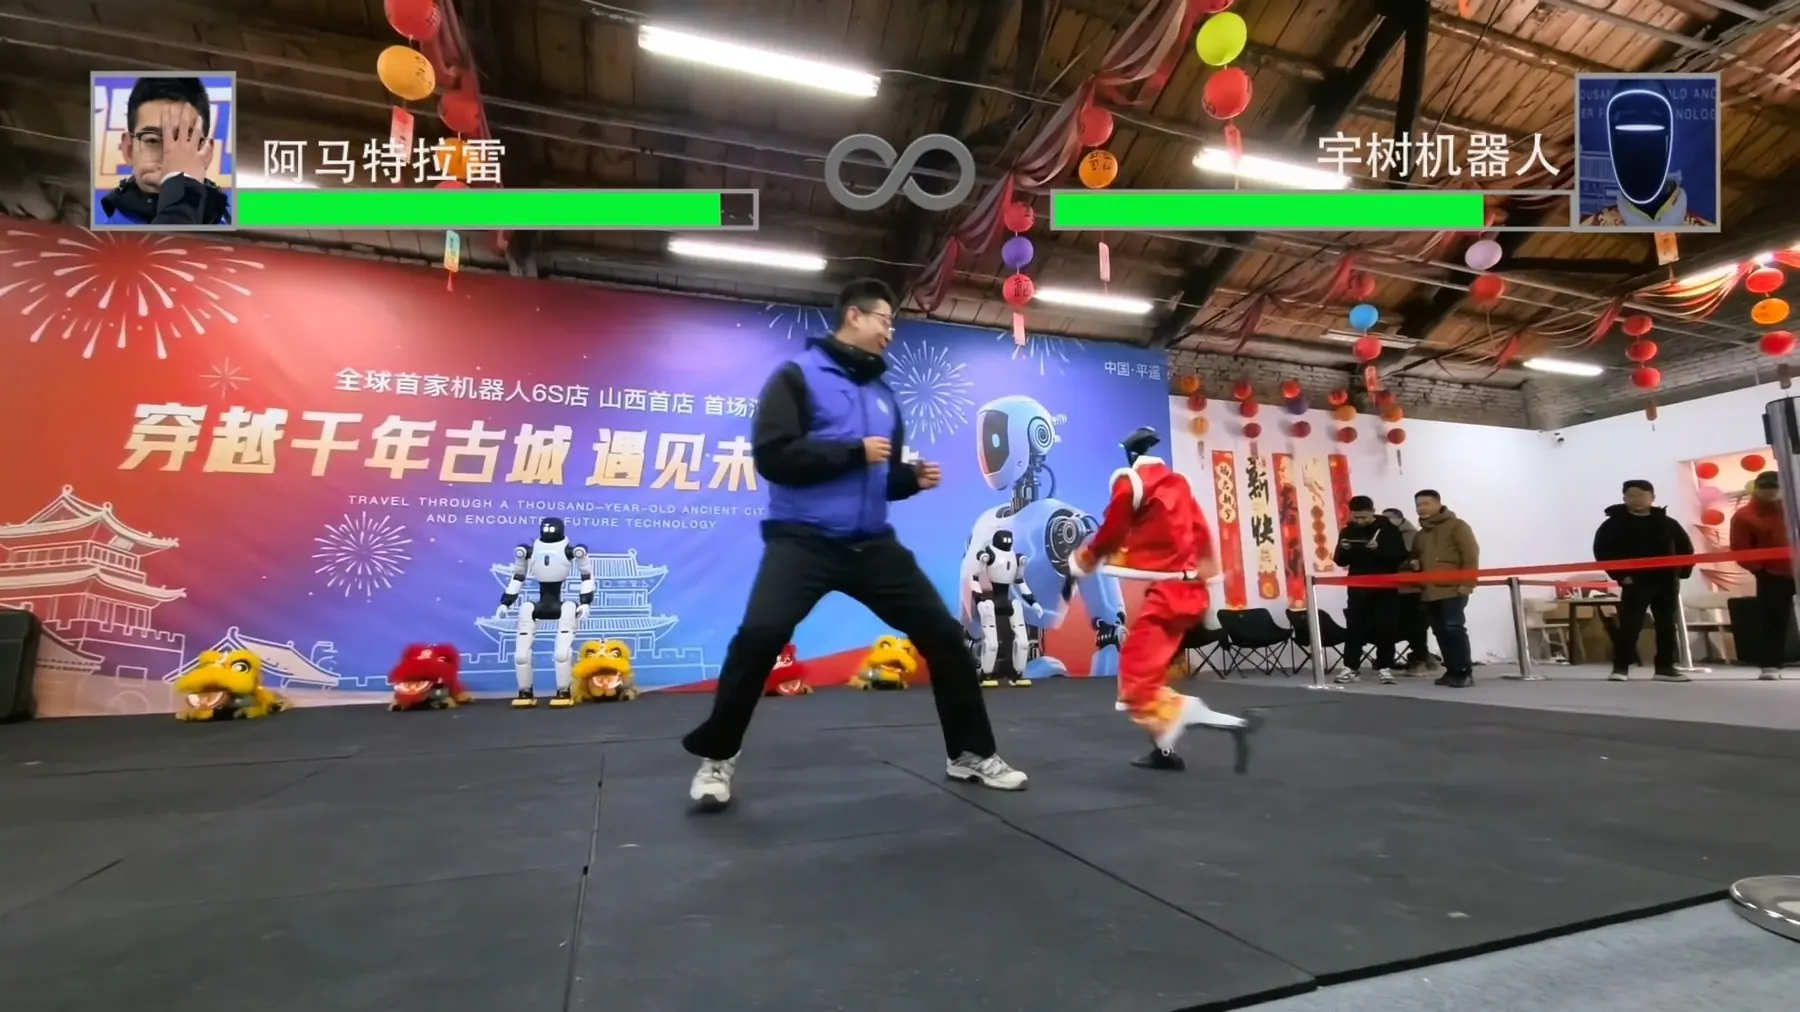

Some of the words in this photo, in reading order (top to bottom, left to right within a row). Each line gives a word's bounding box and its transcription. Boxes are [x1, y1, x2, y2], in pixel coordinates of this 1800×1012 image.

[334, 367, 590, 408] 全球首家机器人6S店
[599, 386, 695, 414] 山西首店
[118, 402, 573, 486] 穿越千年古城
[348, 495, 410, 507] TRAVEL
[419, 497, 493, 509] THROUGH
[500, 501, 510, 509] A
[682, 505, 738, 516] ANCIENT
[744, 507, 766, 516] CIT
[426, 514, 458, 524] AND
[465, 514, 544, 526] ENCOUNTE
[563, 516, 620, 528] FUTURE
[626, 519, 717, 530] TECHNOLOGY
